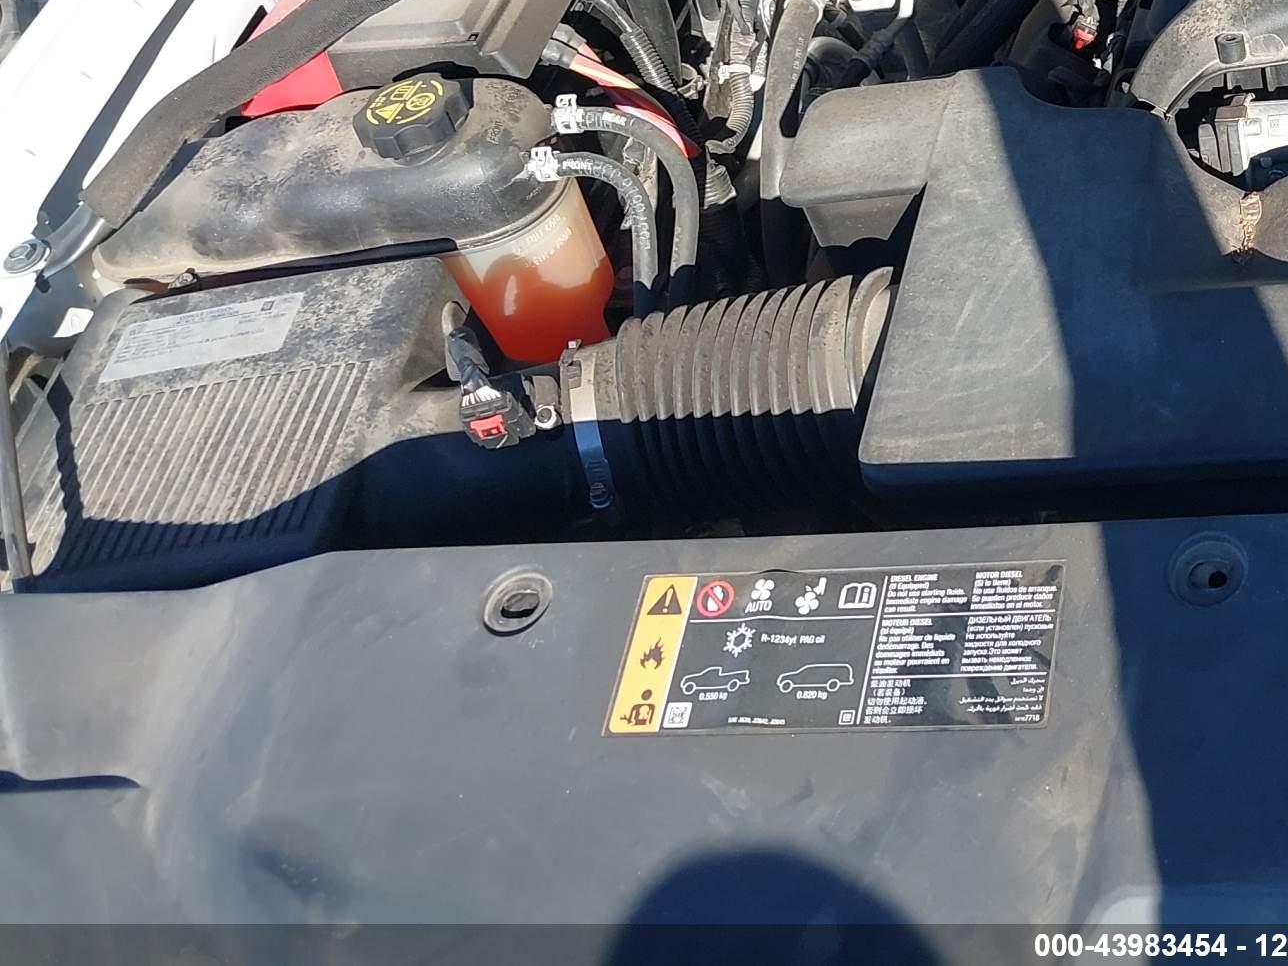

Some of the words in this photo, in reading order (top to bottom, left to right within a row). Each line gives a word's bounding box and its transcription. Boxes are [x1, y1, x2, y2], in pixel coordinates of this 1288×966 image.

[562, 160, 593, 171] FRONT
[744, 600, 772, 614] AUTO
[968, 615, 1011, 625] ДИЗЕЛЬНЫЙ
[1012, 614, 1051, 623] ДВИГАТЕЛЬ
[986, 624, 1023, 632] установлен)
[760, 634, 797, 646] R-1234yf
[800, 635, 814, 644] PAG
[815, 634, 825, 644] oil
[699, 692, 718, 700] 0.550
[719, 692, 728, 700] kg
[796, 690, 817, 699] 0.820
[818, 690, 828, 700] kg
